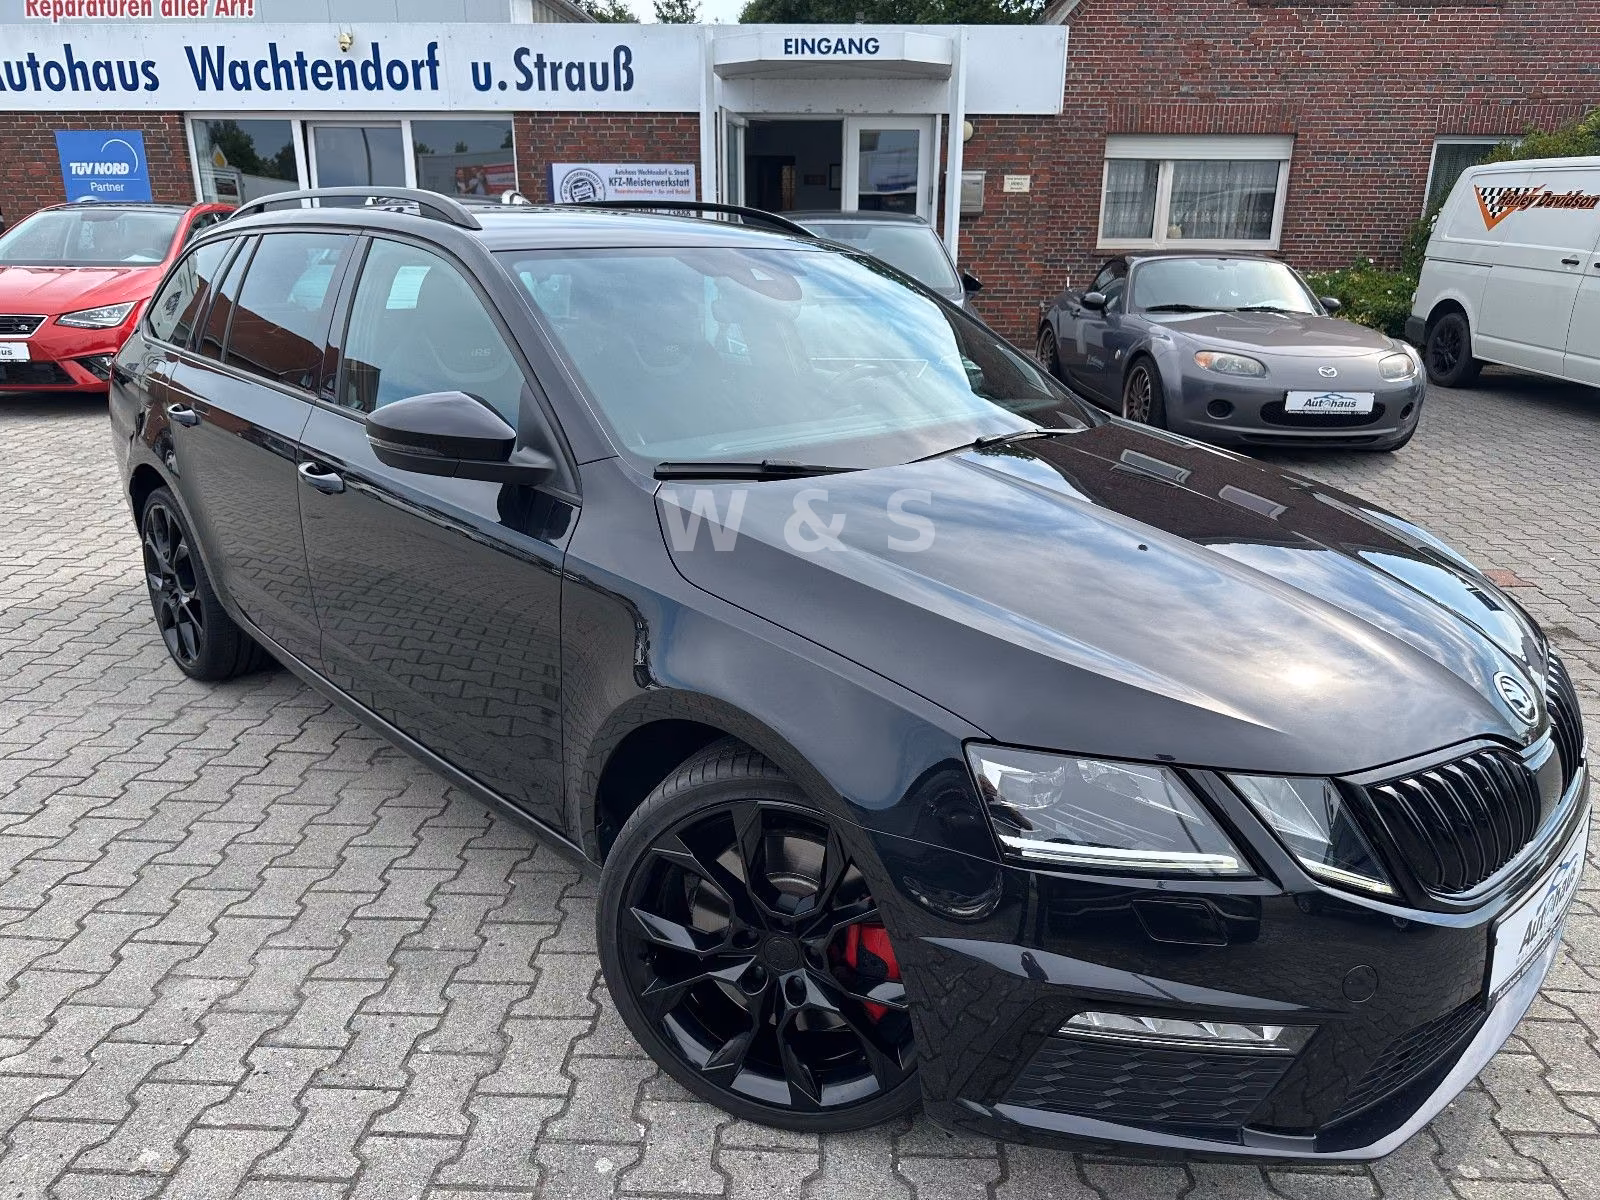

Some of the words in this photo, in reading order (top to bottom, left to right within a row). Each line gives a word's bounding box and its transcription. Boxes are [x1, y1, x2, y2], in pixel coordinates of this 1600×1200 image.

[25, 0, 151, 23] Reparaturen
[161, 0, 206, 17] aller
[215, 0, 254, 17] Art!
[783, 37, 880, 55] EINGANG
[0, 43, 160, 92] utohaus
[184, 42, 439, 91] Wachtendorf
[471, 61, 507, 92] u.
[513, 45, 634, 92] Strauß
[70, 162, 94, 175] TÜV
[94, 162, 130, 175] NORD
[90, 181, 125, 192] Partner
[608, 176, 691, 187] KFZ-Meisterwerkstatt
[1496, 190, 1541, 211] Harley
[1534, 189, 1600, 210] Davidson
[1303, 398, 1357, 408] Autohaus
